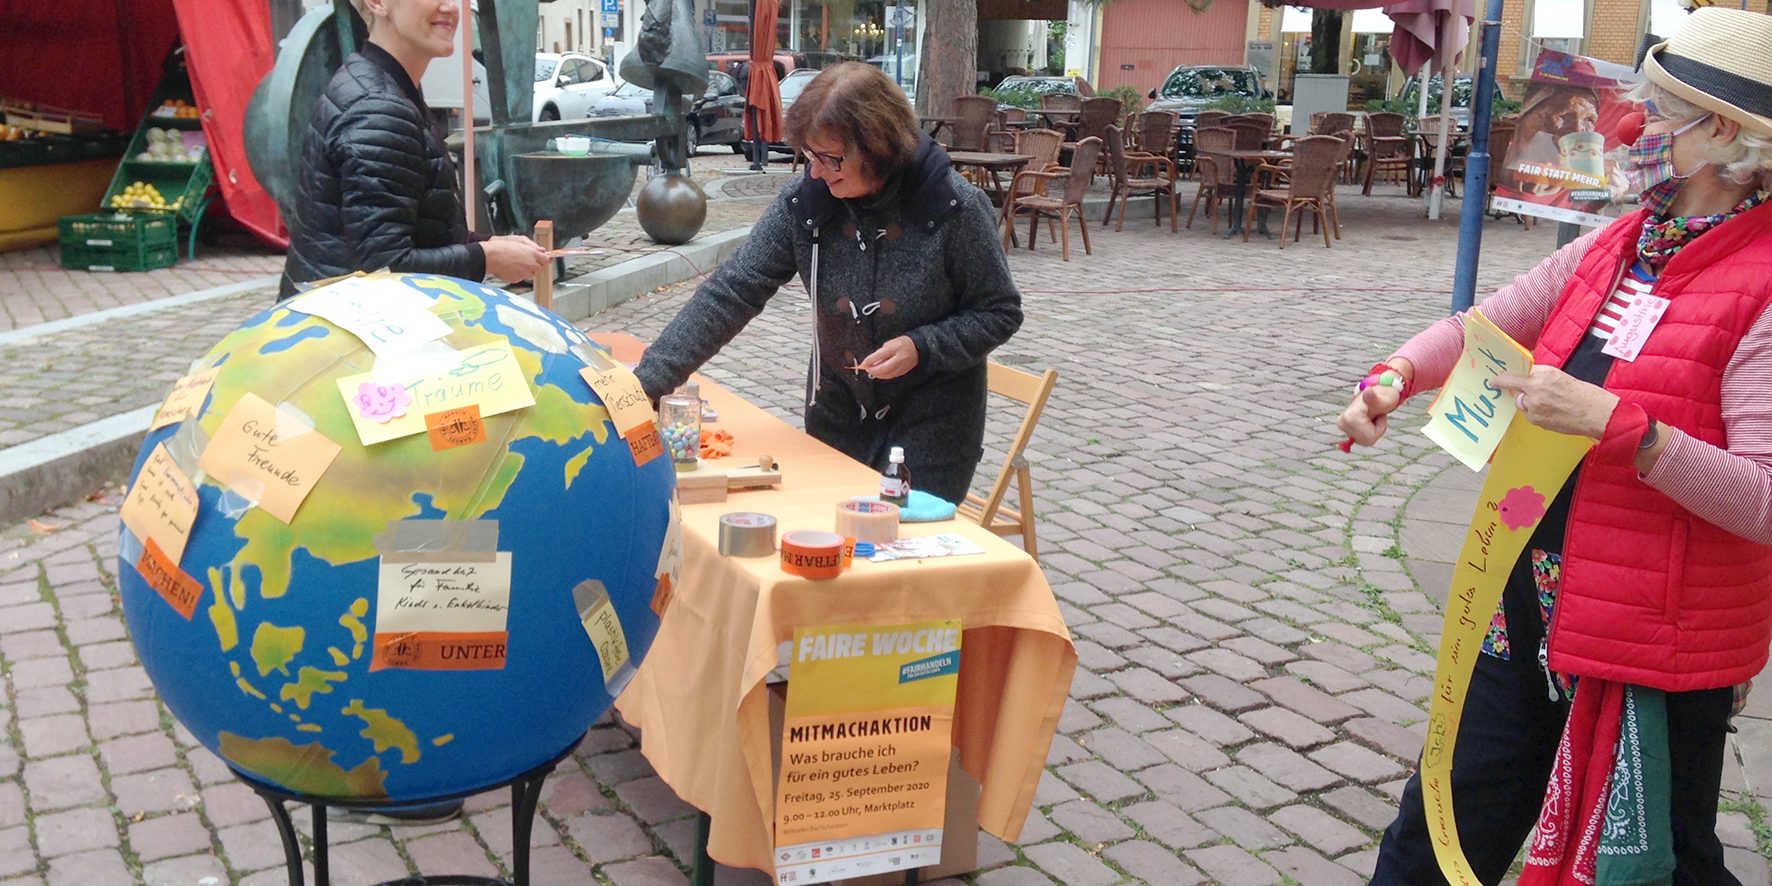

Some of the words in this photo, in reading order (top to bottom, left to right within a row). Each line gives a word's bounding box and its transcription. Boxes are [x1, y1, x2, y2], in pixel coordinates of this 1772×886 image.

[1518, 163, 1542, 176] FAIR
[1543, 167, 1571, 180] STATT
[1571, 172, 1601, 187] MEHR.
[1615, 298, 1657, 354] Augustine
[594, 374, 615, 390] mehr
[1445, 347, 1507, 443] Musik
[242, 420, 280, 447] Gute
[248, 444, 301, 486] Freunde
[798, 631, 868, 663] FAIRE
[872, 627, 959, 657] WOCHE
[1441, 675, 1455, 703] für
[1460, 587, 1477, 630] gutes
[790, 715, 932, 744] MITMACHAKTION
[789, 752, 818, 765] Was
[822, 747, 875, 763] brauche
[877, 744, 896, 757] ich
[786, 771, 807, 784] für
[809, 770, 830, 781] ein
[832, 766, 870, 784] gutes
[872, 760, 920, 776] Leben?
[784, 790, 826, 804] Freitag,
[829, 791, 844, 801] 25.
[846, 783, 905, 799] September
[906, 781, 930, 792] 2020
[783, 812, 805, 825] 9.00
[814, 809, 840, 819] 12.00
[841, 805, 862, 817] Uhr,
[864, 799, 916, 815] Marktplatz
